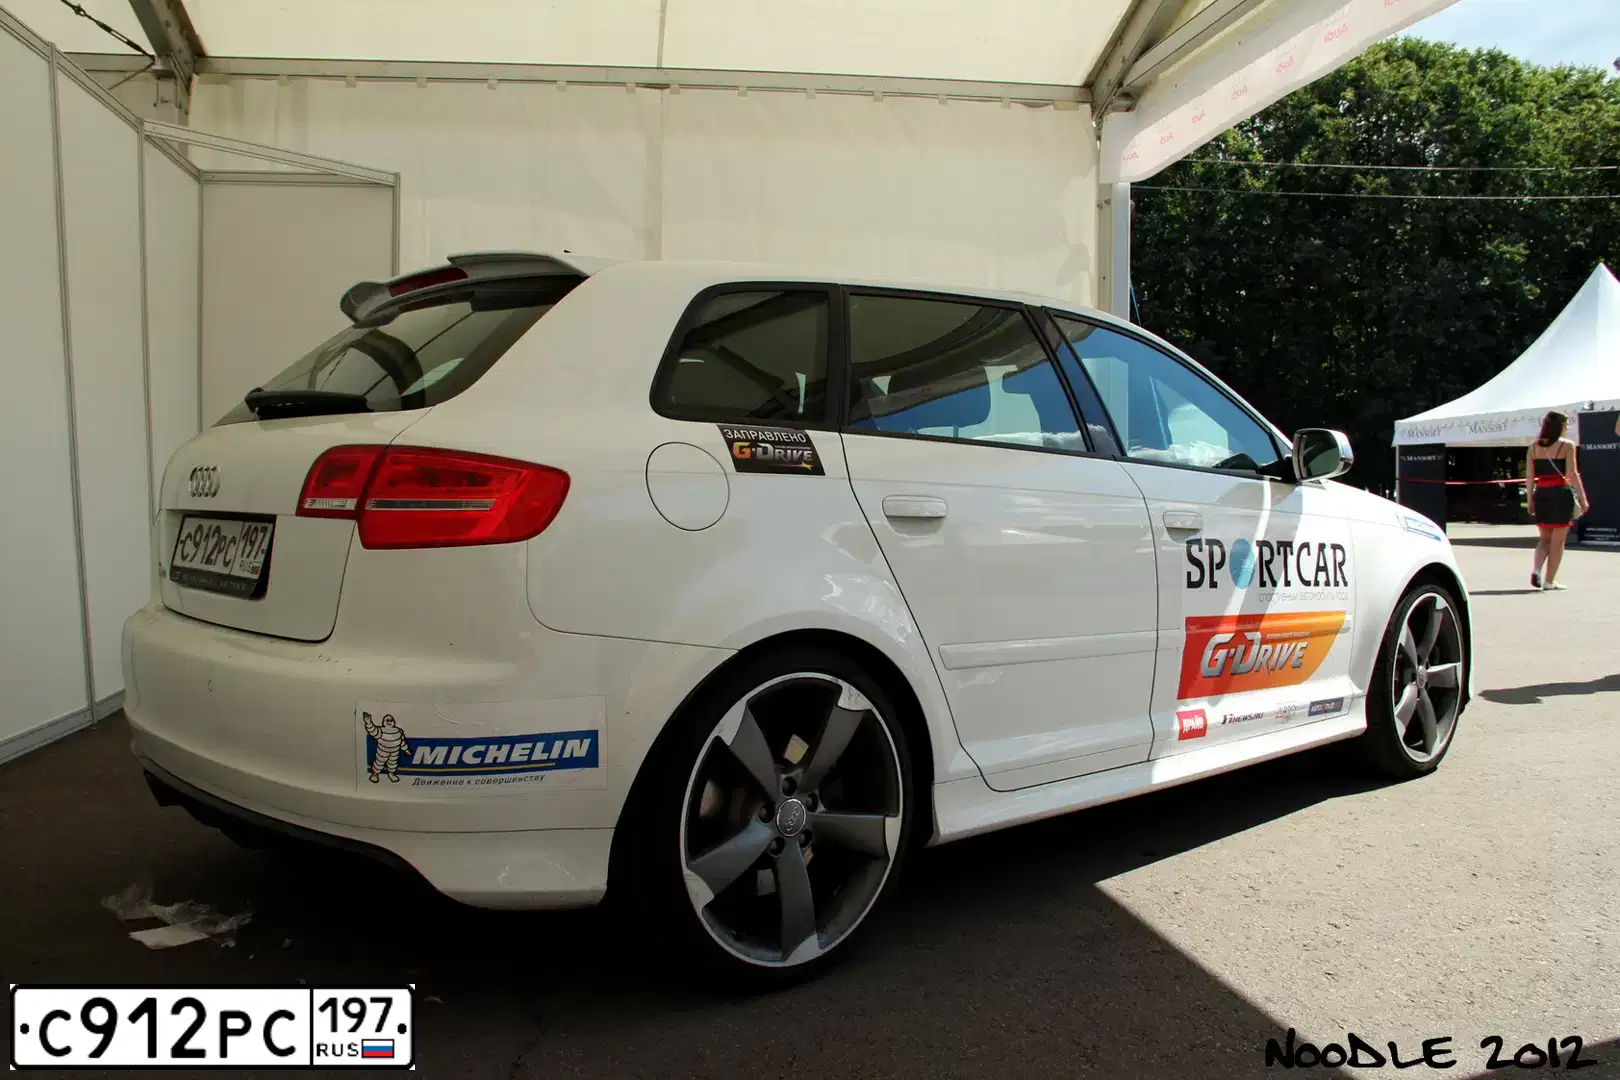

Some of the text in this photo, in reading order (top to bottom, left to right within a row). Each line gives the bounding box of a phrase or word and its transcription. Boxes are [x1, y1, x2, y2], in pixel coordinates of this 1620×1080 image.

[1468, 422, 1508, 435] MANSORY
[723, 429, 807, 443] ЗАПРАВЛЕНО
[1586, 442, 1617, 450] MANSORY
[241, 525, 268, 560] 197
[1186, 537, 1349, 589] SPORTCAR
[411, 738, 592, 765] MICHELIN
[412, 777, 465, 787] Движение
[474, 773, 546, 786] совершенству
